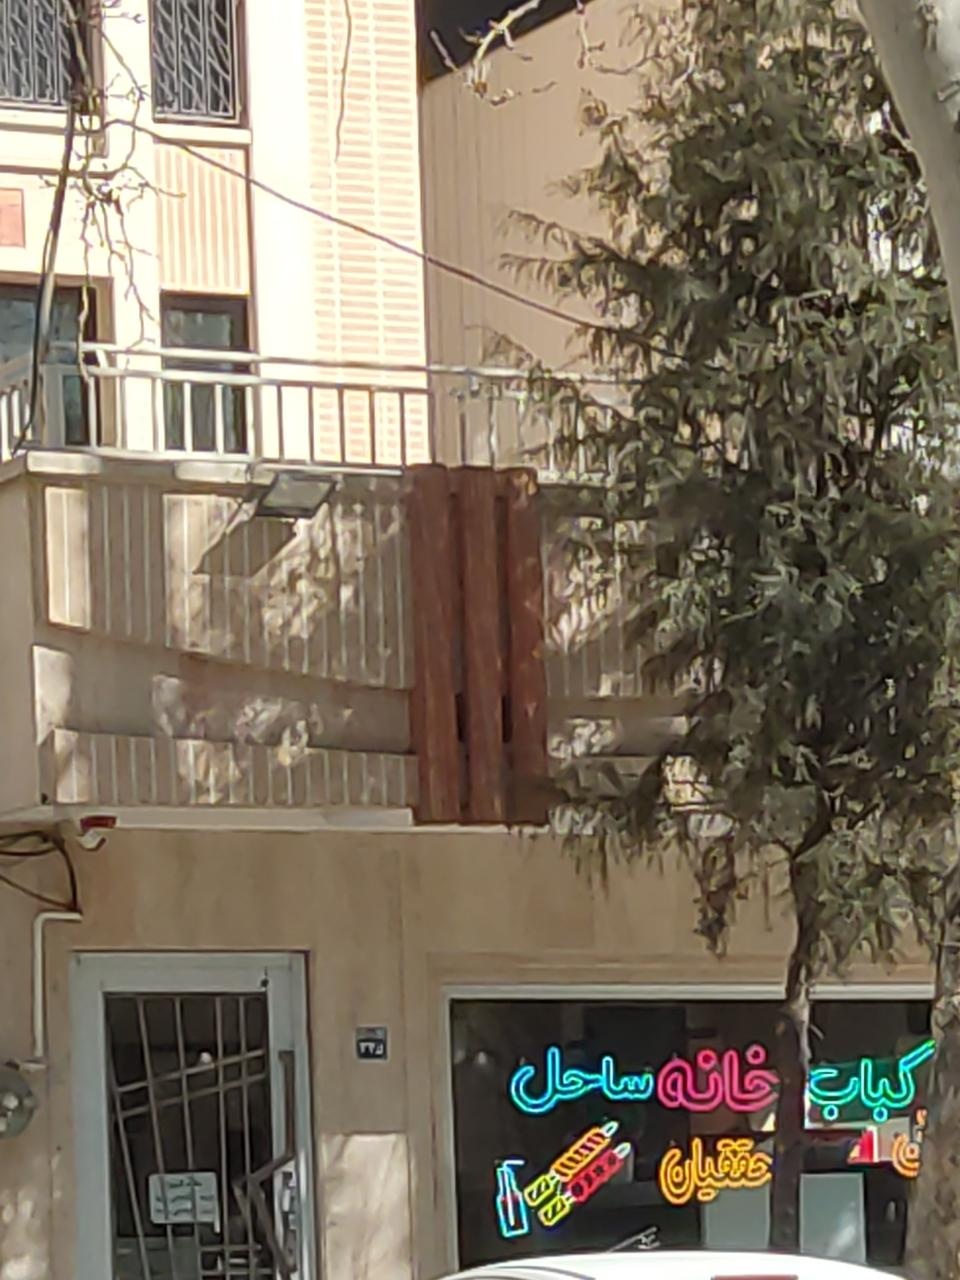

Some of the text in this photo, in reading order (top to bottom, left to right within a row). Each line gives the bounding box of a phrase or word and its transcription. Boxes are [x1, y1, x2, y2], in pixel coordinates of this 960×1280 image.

[510, 1038, 936, 1122] کباب خانه ساحل
